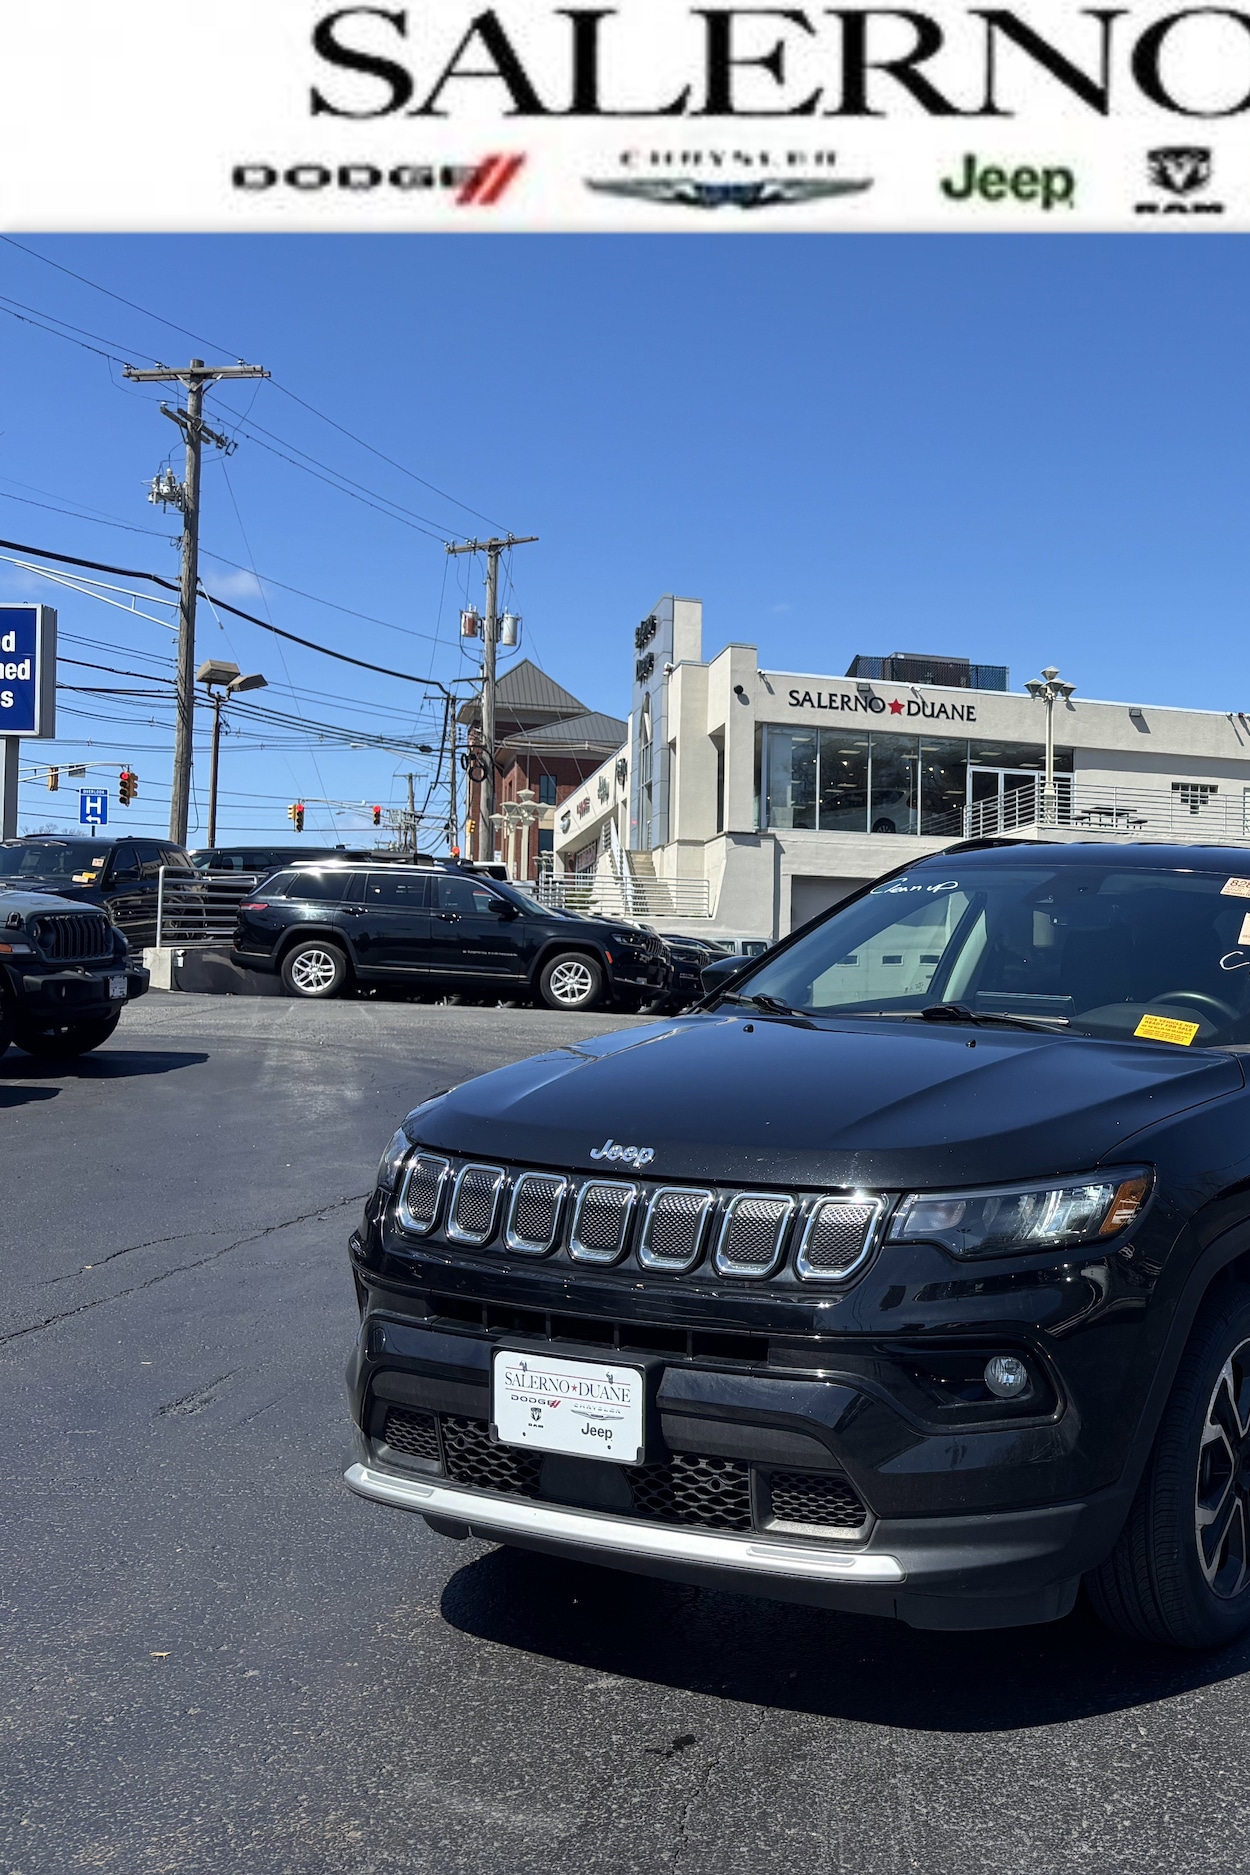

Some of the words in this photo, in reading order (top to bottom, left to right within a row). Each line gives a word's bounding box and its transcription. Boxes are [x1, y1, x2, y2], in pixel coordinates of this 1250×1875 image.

[0, 630, 16, 653] d
[788, 689, 886, 714] SALERNO
[907, 699, 977, 722] DUANE
[86, 796, 102, 815] H
[589, 1138, 655, 1168] Jeep
[504, 1371, 570, 1394] SALERNO
[578, 1382, 631, 1403] DUANE
[581, 1422, 613, 1440] Jeep
